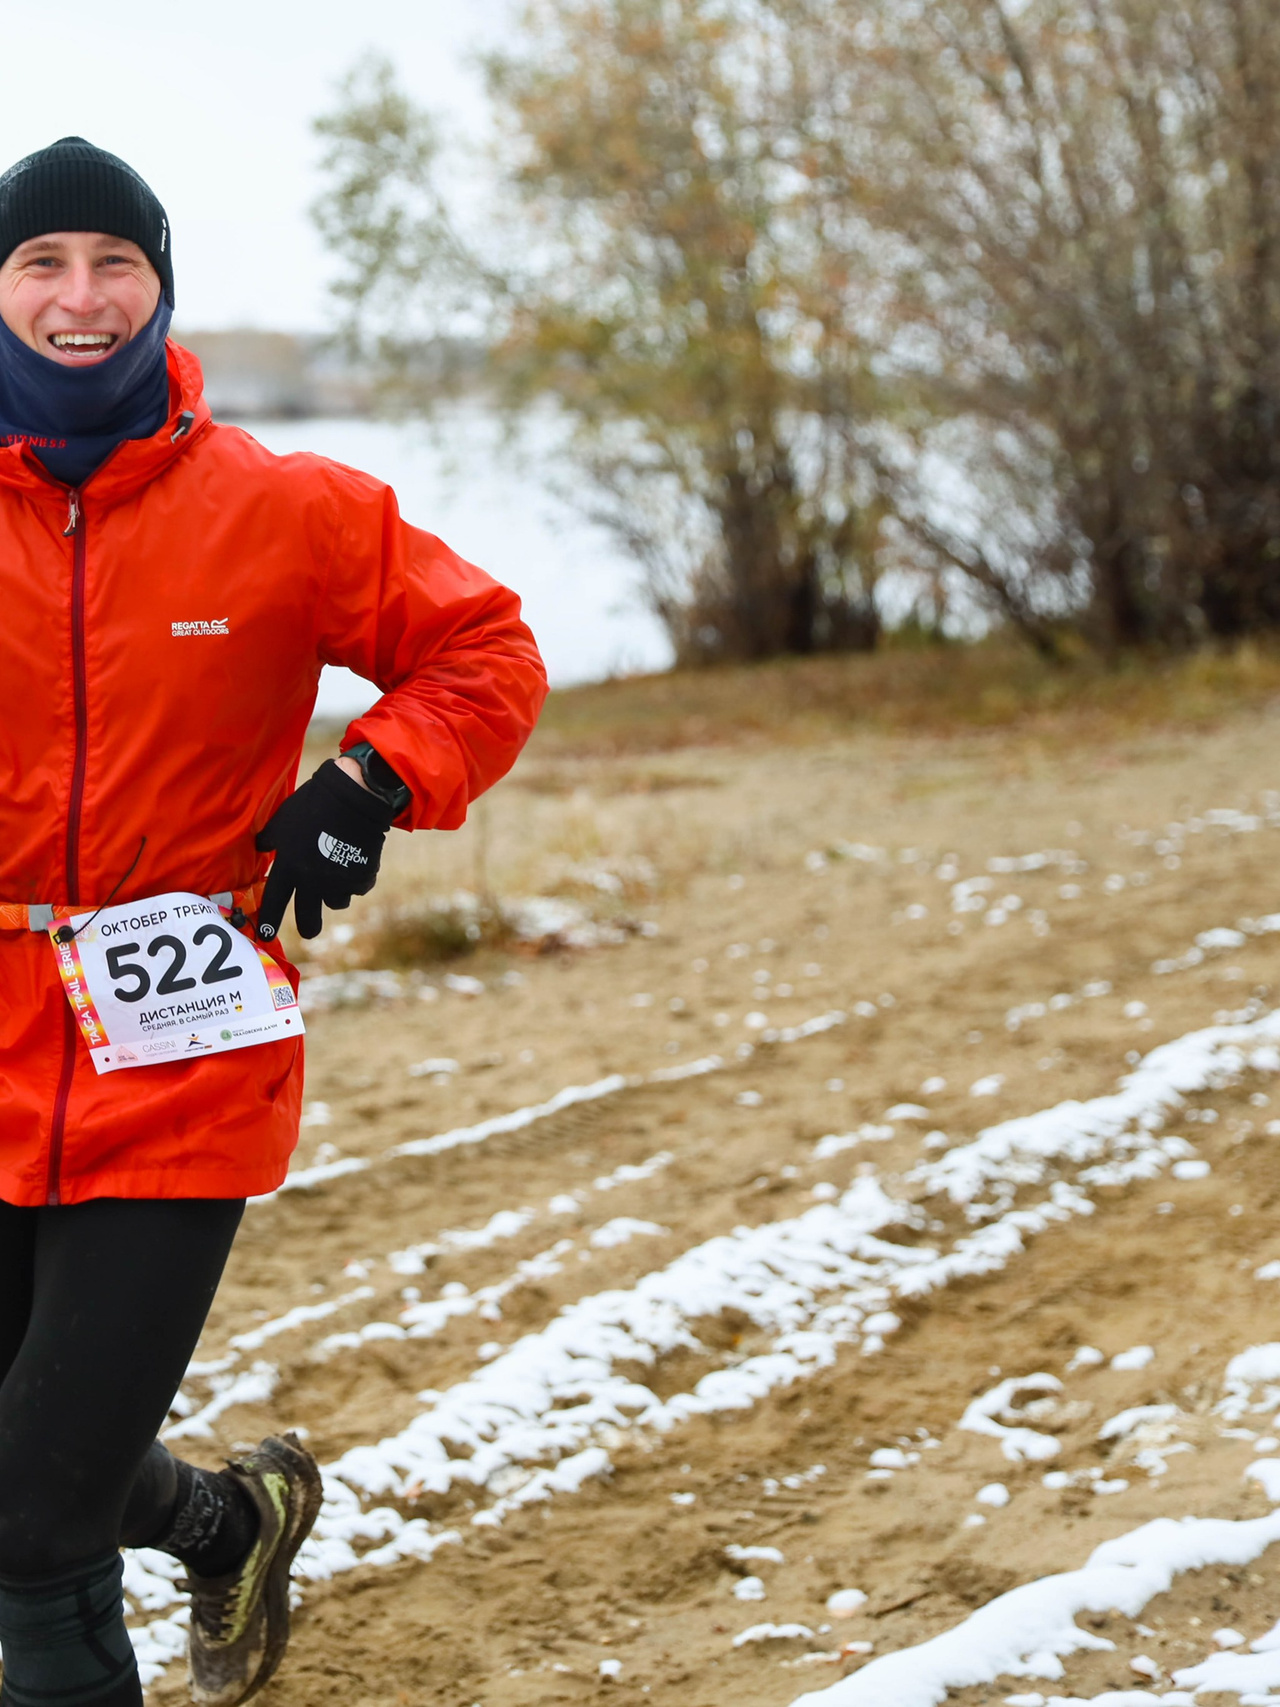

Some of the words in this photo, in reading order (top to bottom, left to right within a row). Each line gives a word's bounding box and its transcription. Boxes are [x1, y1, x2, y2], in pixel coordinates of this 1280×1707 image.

[171, 621, 210, 631] REGATTA
[171, 629, 192, 637] GREAT
[193, 628, 229, 636] OUTDOORS
[329, 853, 350, 868] THE
[332, 847, 369, 865] NORTH
[335, 840, 362, 856] FACE
[101, 910, 168, 937] ОКТОБЕР
[58, 942, 77, 977] SERIE
[105, 923, 243, 1003] 522
[68, 977, 88, 1012] TRAIL
[139, 994, 227, 1026] ДИСТАНЦИЯ
[142, 1020, 179, 1032] СРЕДНЯЯ,
[186, 1011, 214, 1023] САМЫЙ
[215, 1007, 230, 1017] РАЗ
[81, 1010, 102, 1046] TAIGA
[142, 1040, 177, 1053] CASSINI
